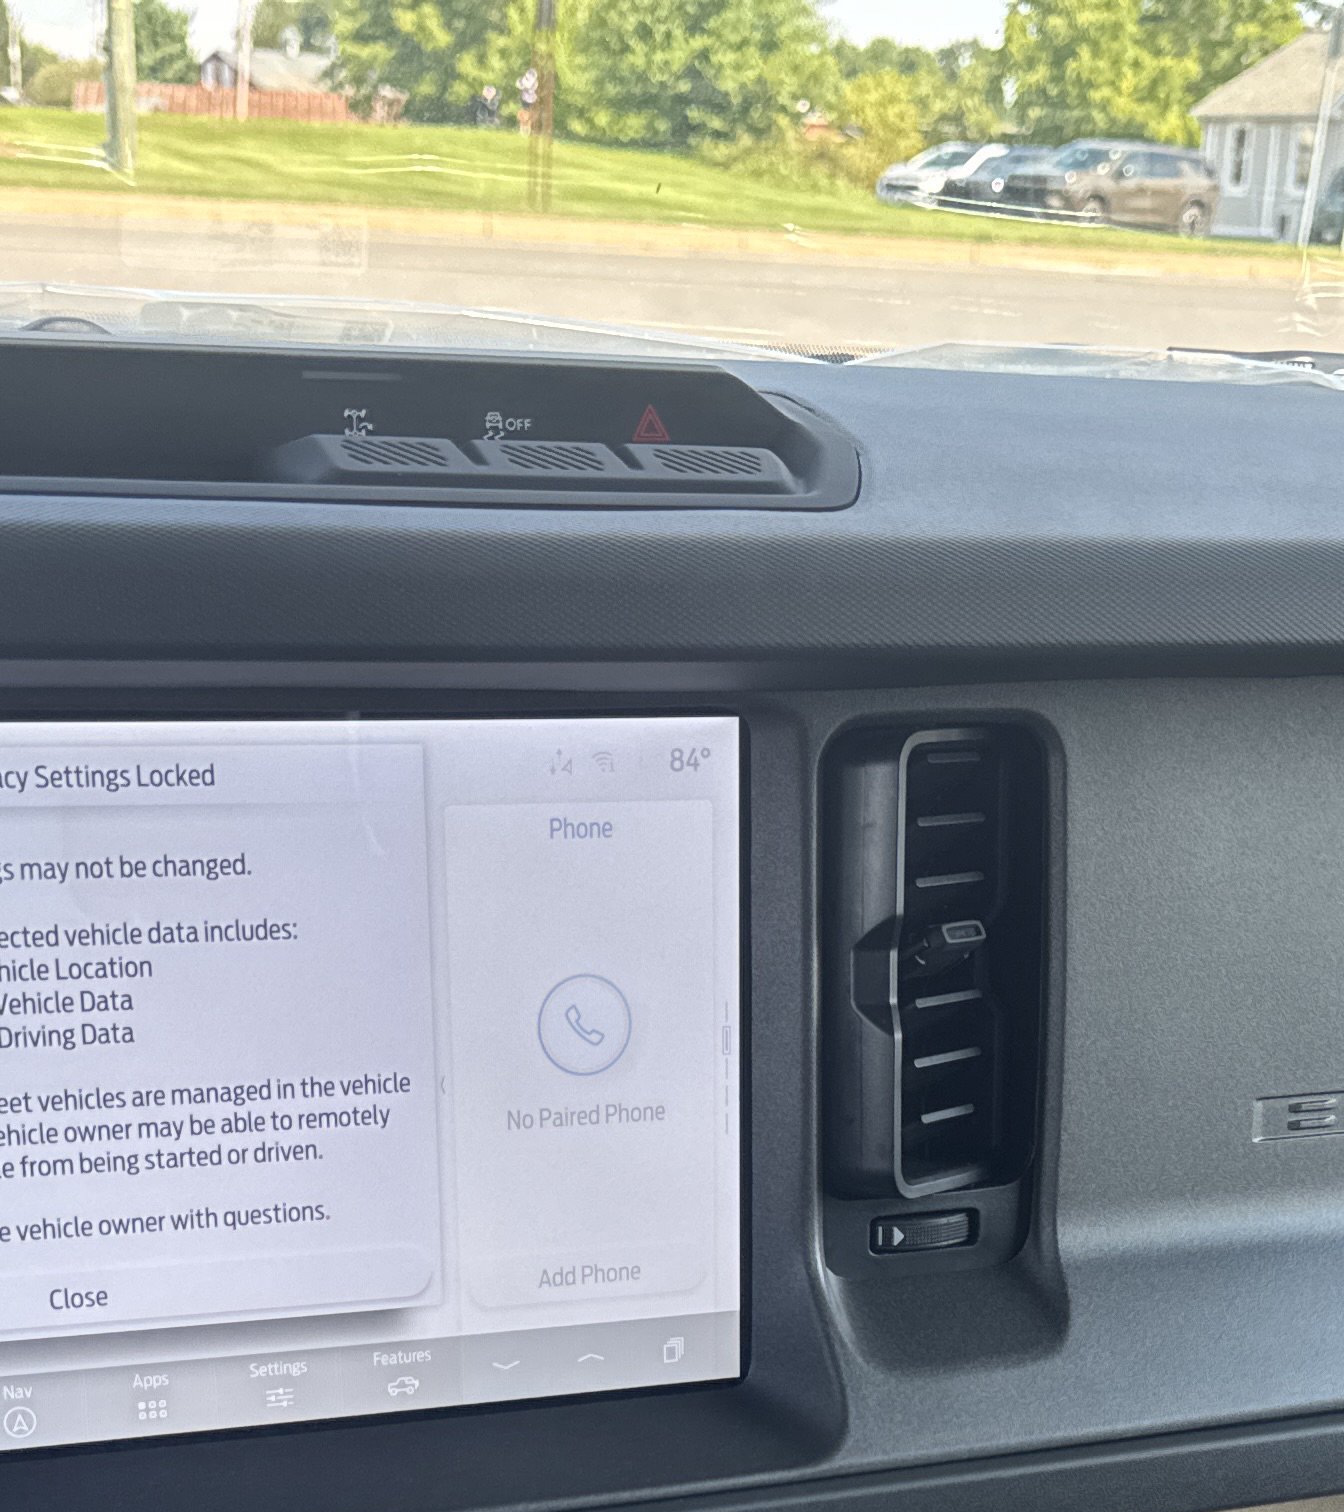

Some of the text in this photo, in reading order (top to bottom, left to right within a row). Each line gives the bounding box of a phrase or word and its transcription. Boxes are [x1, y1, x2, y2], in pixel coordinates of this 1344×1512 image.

[505, 417, 532, 432] OFF
[669, 748, 711, 772] 84°
[34, 764, 131, 792] Settings
[136, 763, 216, 788] Locked
[549, 817, 613, 839] Phone
[19, 863, 69, 883] may
[74, 859, 114, 880] not
[119, 855, 148, 878] be
[152, 853, 253, 881] changed.
[63, 922, 143, 947] vehicle
[147, 921, 200, 944] data
[203, 918, 299, 943] includes:
[56, 956, 153, 981] Location
[79, 989, 134, 1013] Data
[81, 1022, 135, 1046] Data
[37, 1087, 127, 1112] vehicles
[132, 1088, 166, 1108] are
[171, 1079, 272, 1108] managed
[276, 1078, 295, 1100] in
[300, 1075, 336, 1098] the
[339, 1072, 411, 1096] vehicle
[64, 1121, 132, 1143] owner
[138, 1119, 184, 1141] may
[189, 1113, 216, 1136] be
[221, 1110, 266, 1134] able
[271, 1110, 293, 1131] to
[298, 1104, 390, 1129] remotely
[507, 1102, 666, 1131] No Paired Phone
[19, 1154, 74, 1177] from
[79, 1151, 140, 1175] being
[144, 1144, 222, 1170] started
[227, 1146, 249, 1165] or
[253, 1140, 323, 1164] driven.
[16, 1217, 94, 1242] vehicle
[98, 1215, 167, 1239] owner
[169, 1207, 219, 1231] with
[223, 1203, 331, 1229] questions.
[537, 1262, 641, 1289] Add Phone
[49, 1286, 109, 1311] Close
[249, 1359, 308, 1379] Settings
[372, 1348, 432, 1366] Features
[2, 1384, 33, 1401] Nav
[132, 1371, 169, 1389] Apps
